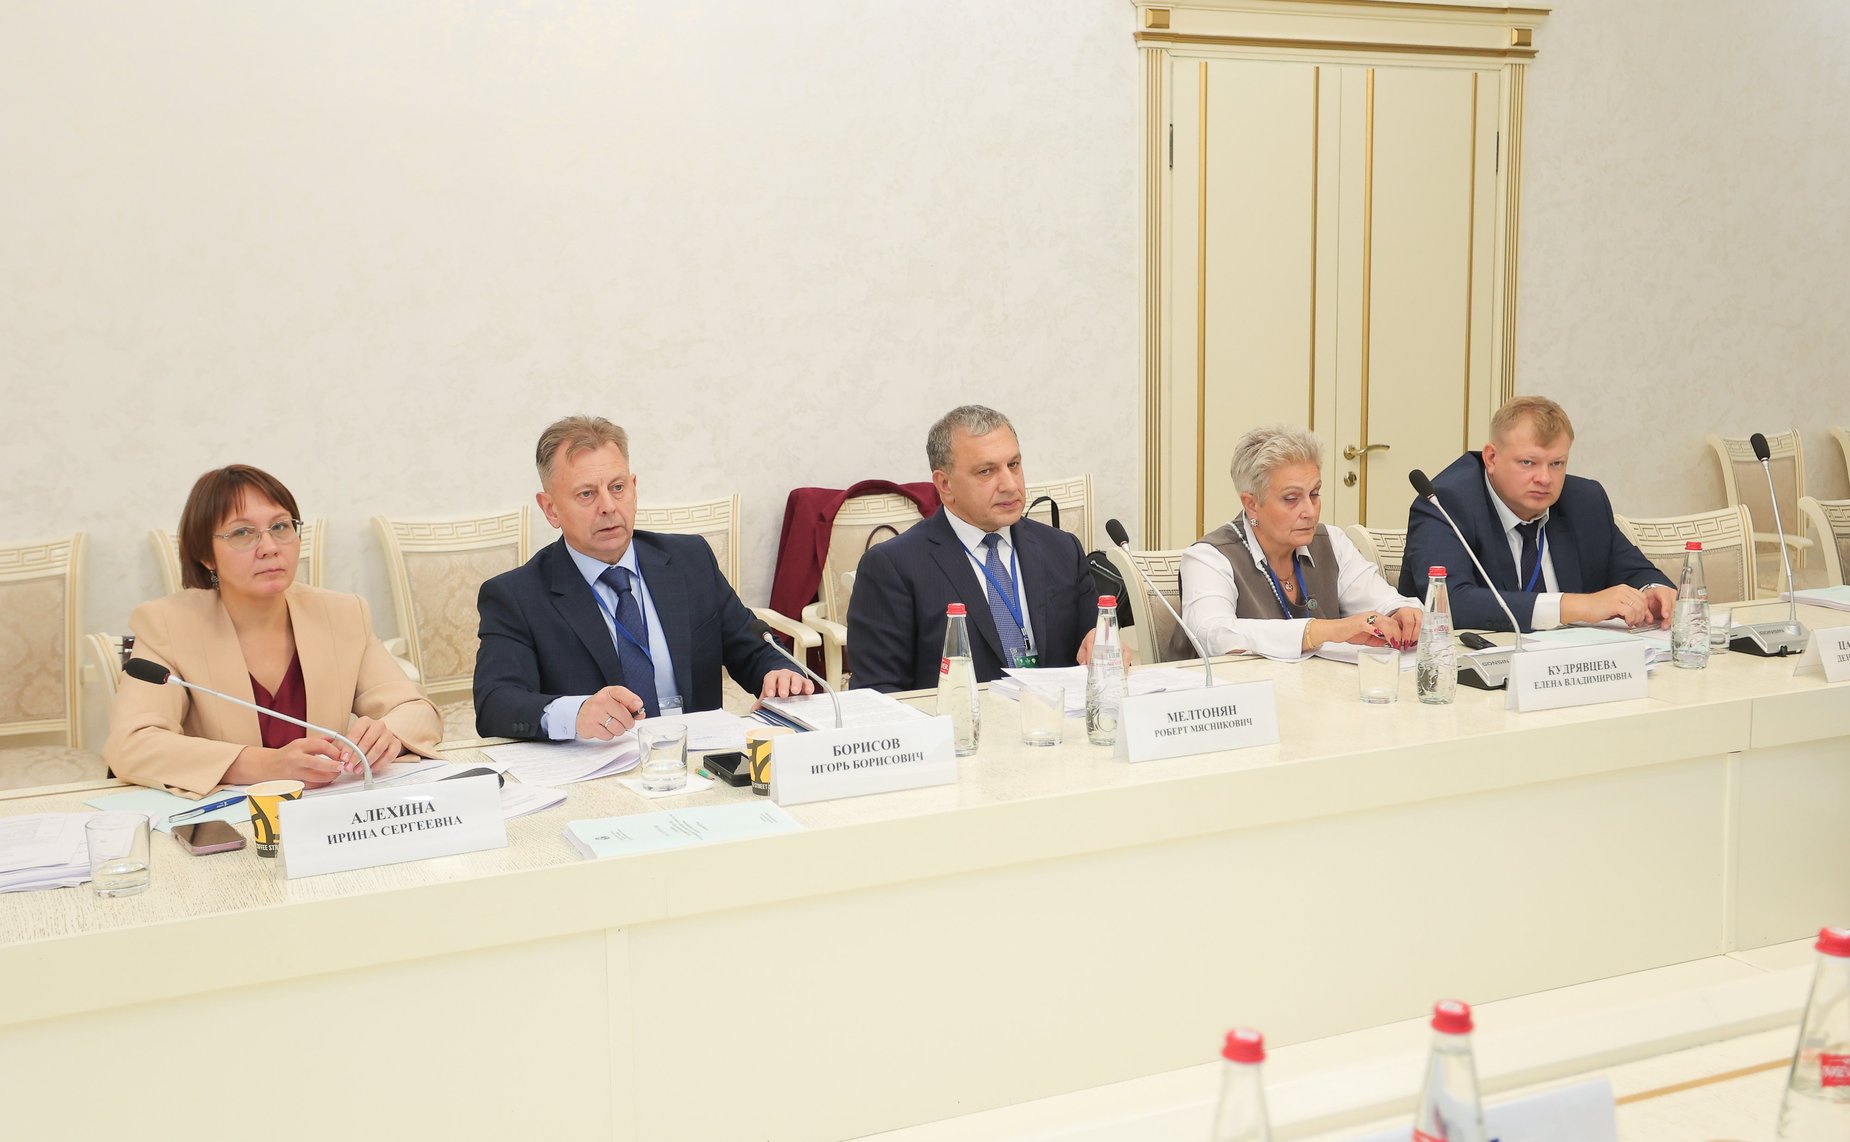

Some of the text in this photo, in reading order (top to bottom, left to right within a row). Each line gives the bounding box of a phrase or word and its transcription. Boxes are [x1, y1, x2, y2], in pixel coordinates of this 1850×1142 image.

[1547, 660, 1617, 676] КУДРЯВЦЕВА
[1534, 672, 1633, 690] ЕЛЕНА ВЛАДИМИРОВНА
[1167, 705, 1237, 723] МЕЛТОНЯН
[1154, 718, 1253, 738] РОБЕРТ МЯСНИКОВИЧ
[833, 738, 901, 757] БОРИСОВ
[811, 752, 924, 775] ИГОРЬ БОРИСОВИЧ
[351, 801, 436, 825] АЛЕХИНА
[327, 815, 463, 845] ИРИНА СЕРГЕЕВНА
